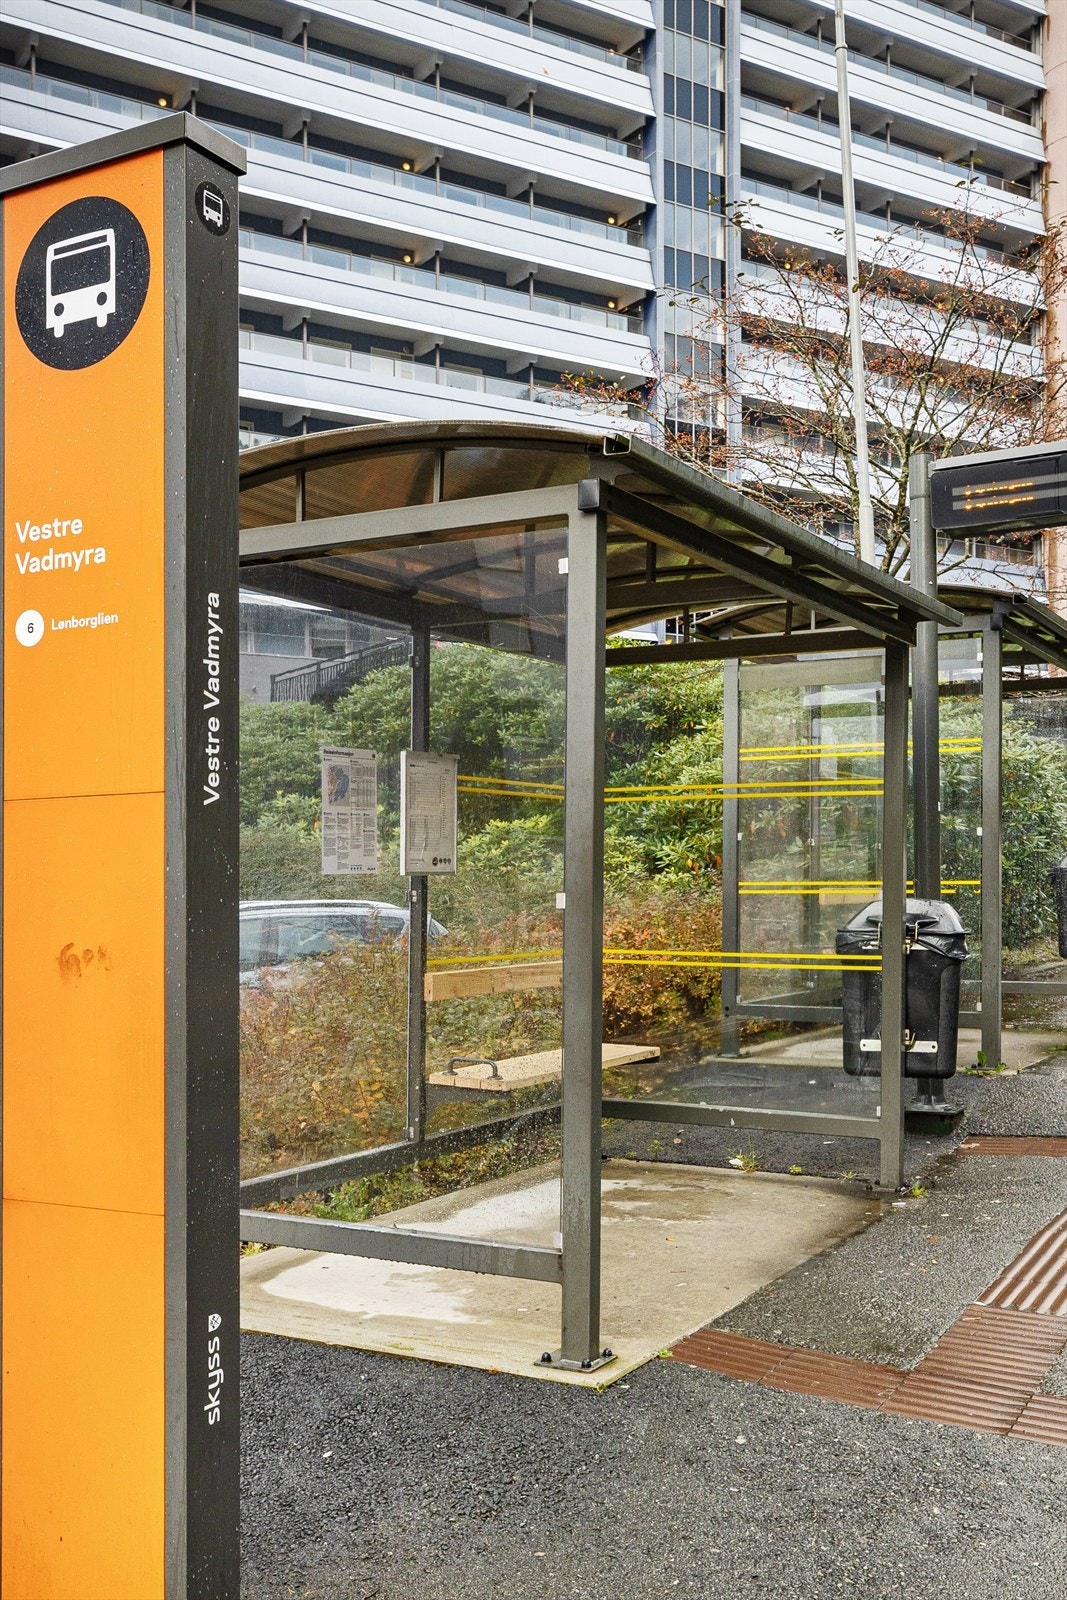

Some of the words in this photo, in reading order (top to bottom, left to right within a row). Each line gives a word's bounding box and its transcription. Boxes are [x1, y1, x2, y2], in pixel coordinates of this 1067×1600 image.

[15, 518, 83, 543] Vestre
[15, 547, 107, 575] Vadmyra
[27, 622, 35, 634] 6
[51, 612, 119, 631] Lønborglien
[203, 592, 223, 710] Vadmyra
[203, 716, 220, 806] Vestre
[203, 1336, 224, 1425] skyss
